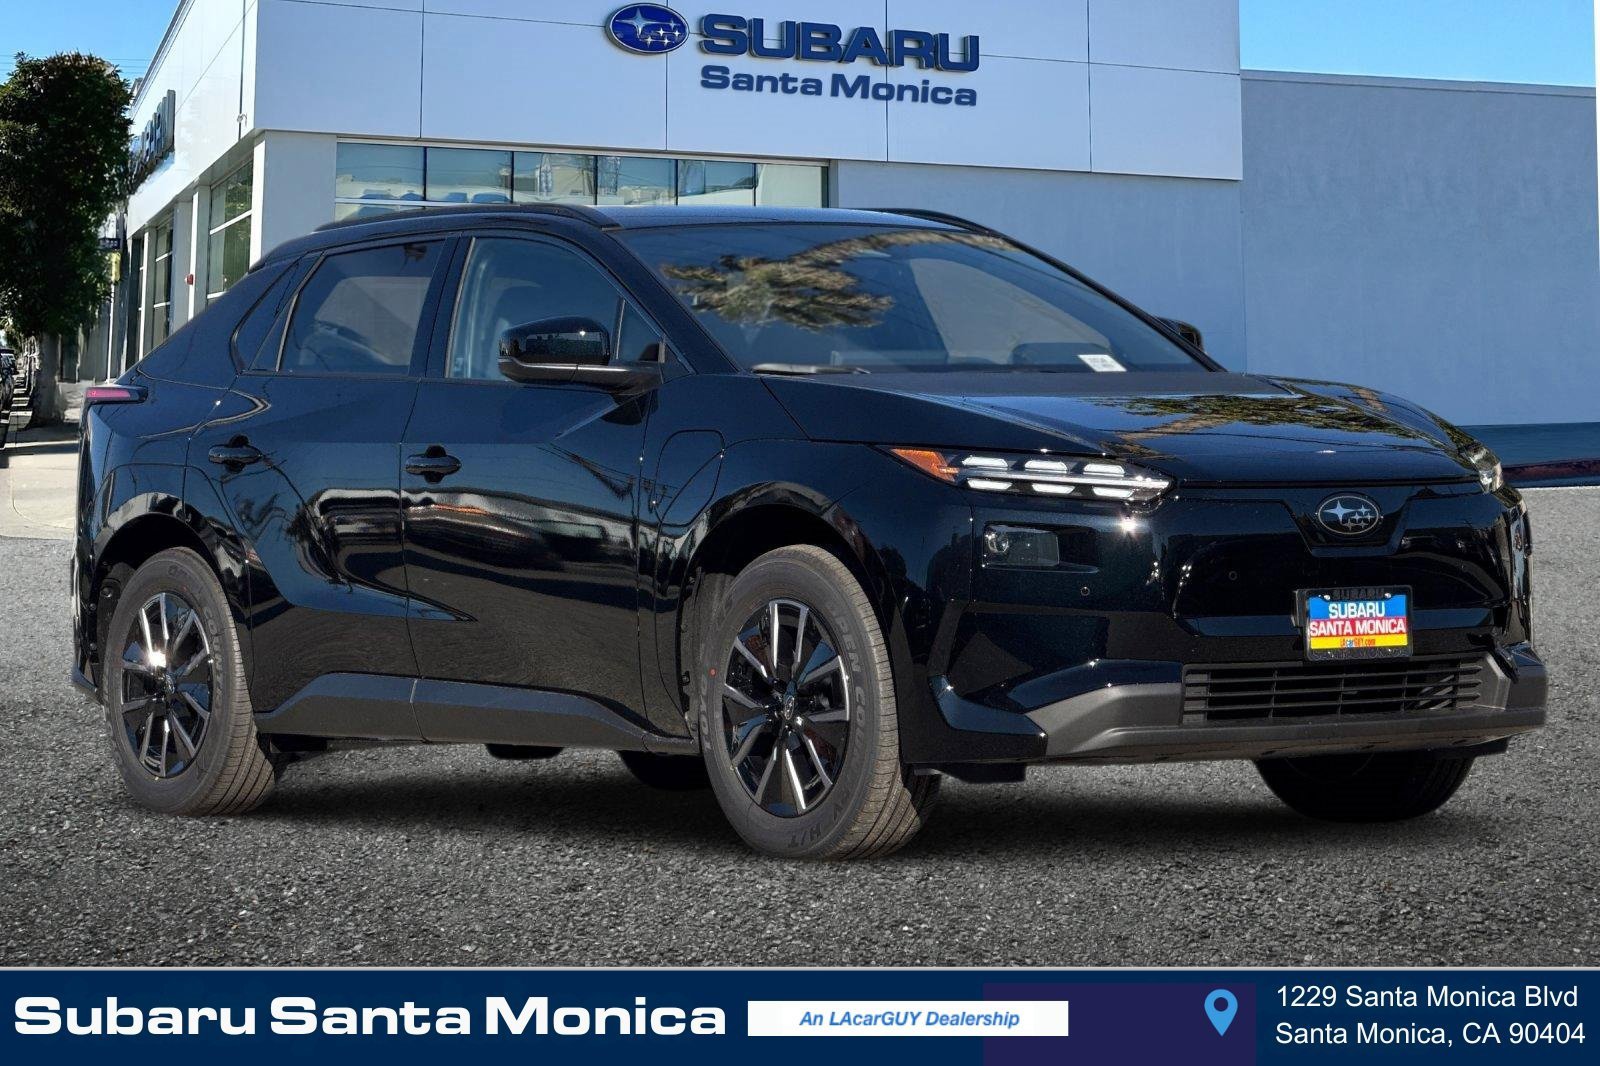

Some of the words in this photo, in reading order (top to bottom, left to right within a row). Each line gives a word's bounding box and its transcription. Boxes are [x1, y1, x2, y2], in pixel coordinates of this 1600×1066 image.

[700, 13, 980, 72] SUBARU
[700, 64, 823, 97] Santa
[830, 73, 978, 106] Monica
[1328, 601, 1386, 619] SUBARU
[1308, 621, 1352, 637] SANTA
[1355, 618, 1407, 635] MONICA
